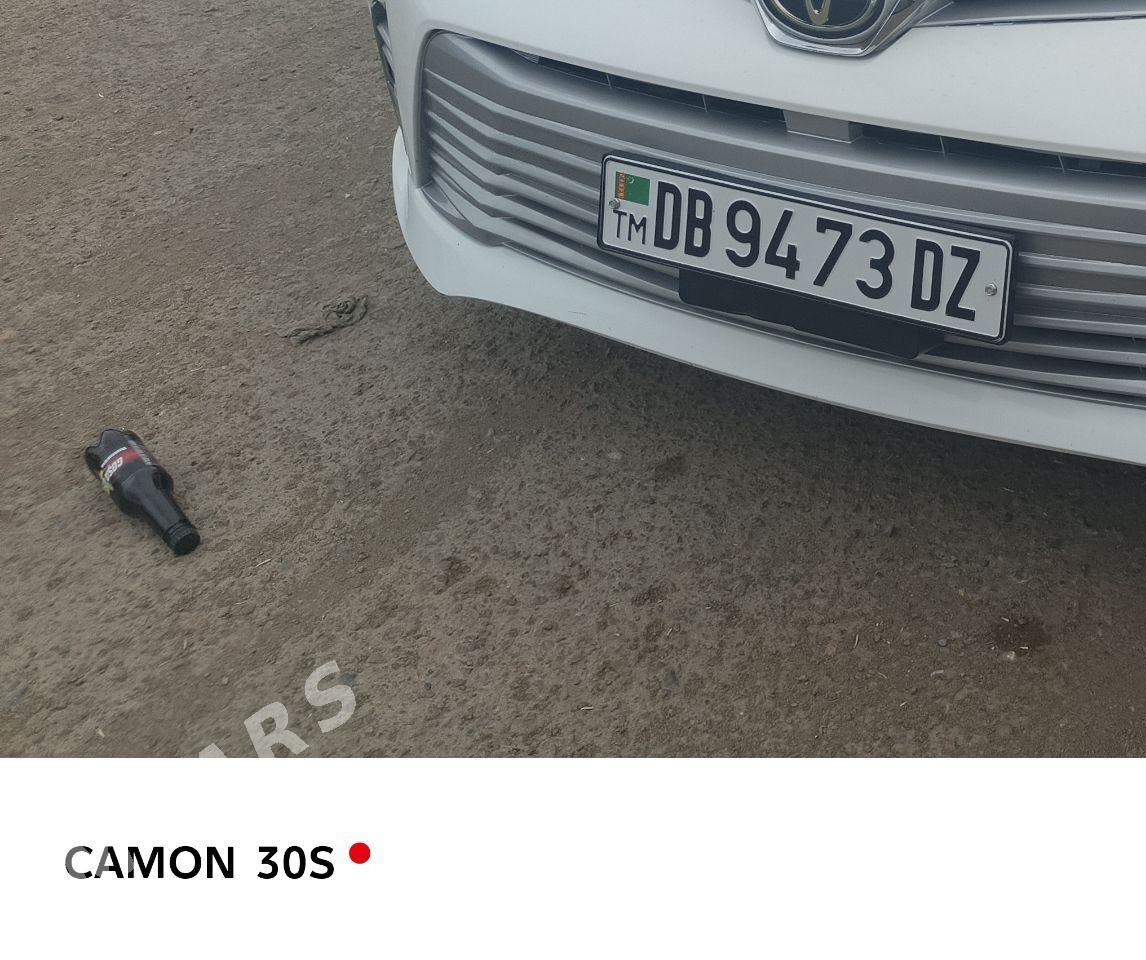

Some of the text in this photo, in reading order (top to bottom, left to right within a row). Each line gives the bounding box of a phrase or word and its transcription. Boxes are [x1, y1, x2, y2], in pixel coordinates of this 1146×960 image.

[612, 209, 647, 245] TM
[654, 181, 981, 322] DB 9473 DZ
